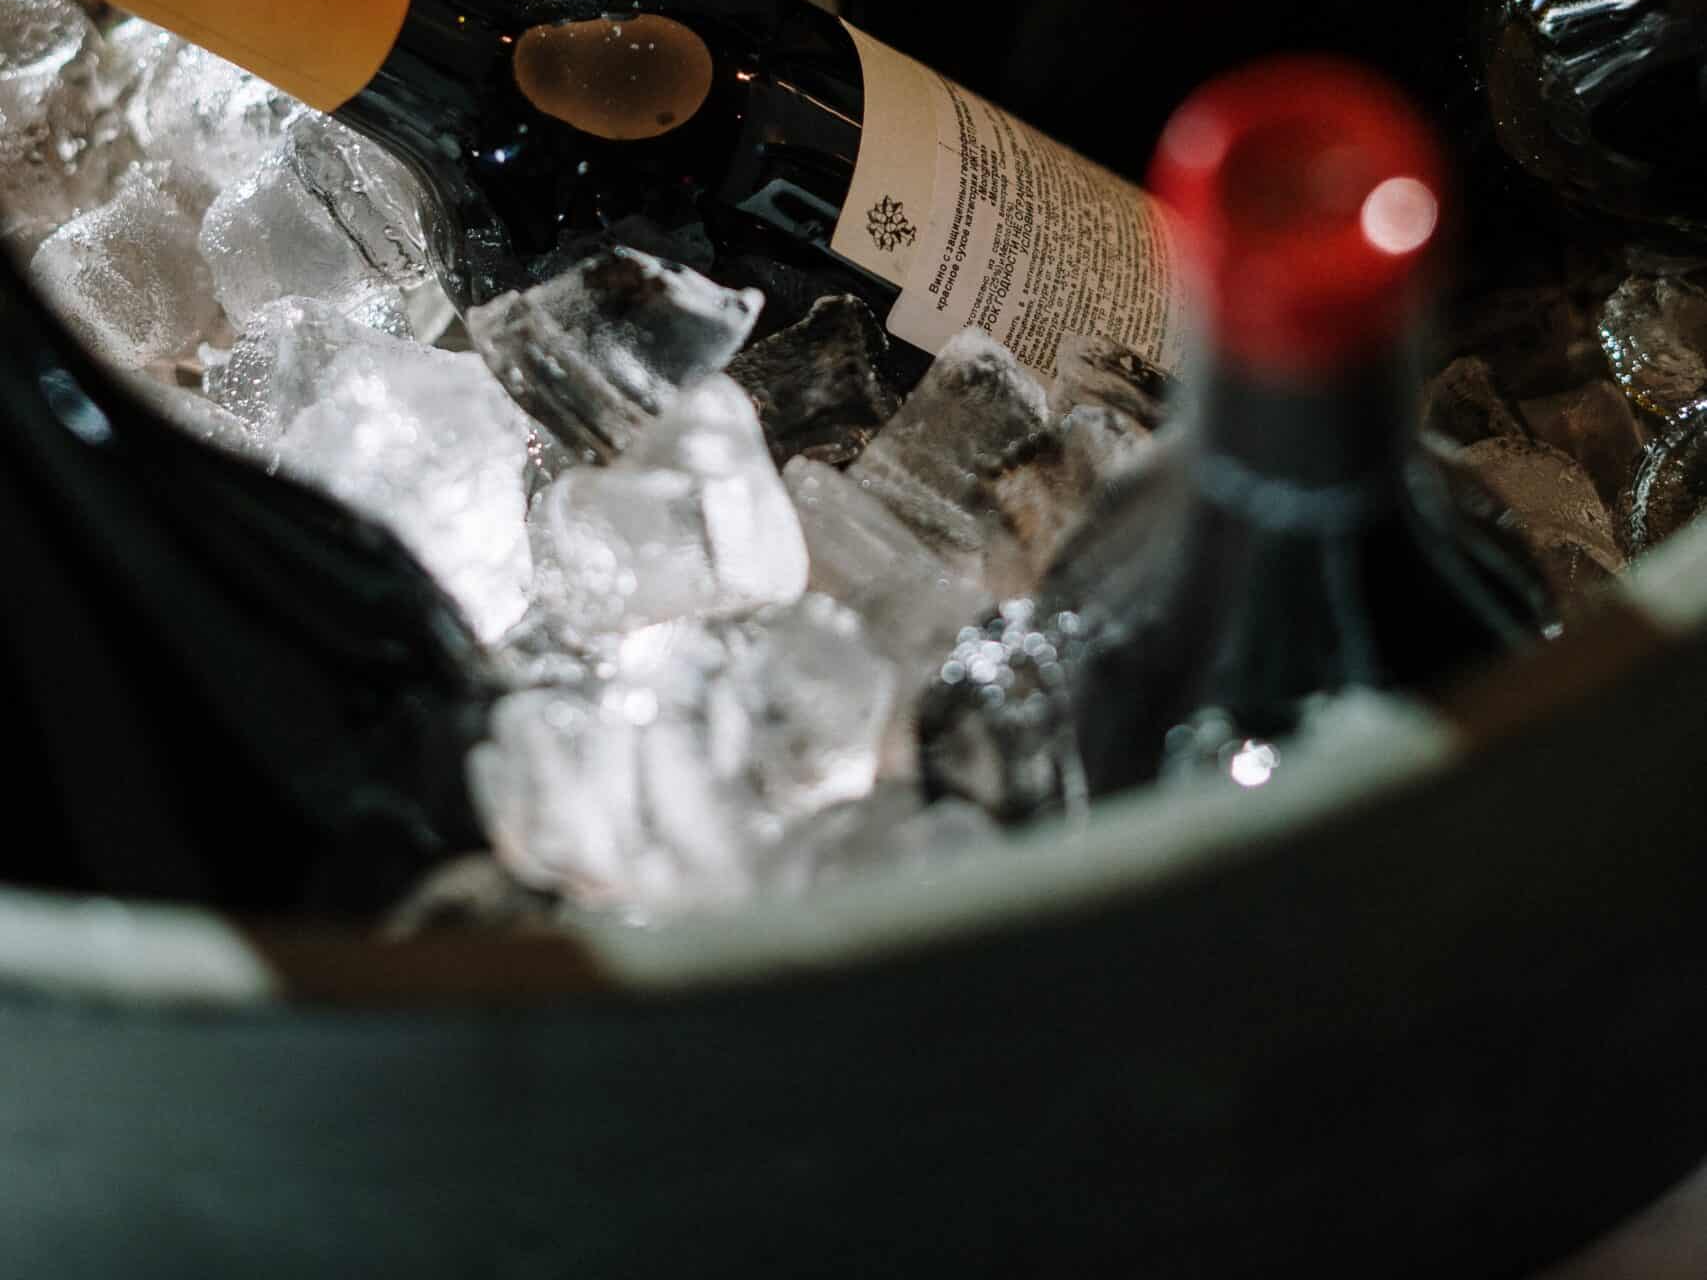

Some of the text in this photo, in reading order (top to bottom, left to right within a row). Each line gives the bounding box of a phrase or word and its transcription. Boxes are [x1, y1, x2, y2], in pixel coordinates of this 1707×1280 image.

[945, 176, 965, 253] защищенным
[928, 261, 947, 295] Вино
[935, 261, 960, 313] красное
[954, 227, 970, 263] сухое
[942, 252, 950, 263] с
[993, 238, 1020, 306] ГОДНОСТИ
[1012, 221, 1021, 240] НЕ
[962, 273, 990, 329] зготовлено
[1002, 313, 1020, 348] ранить
